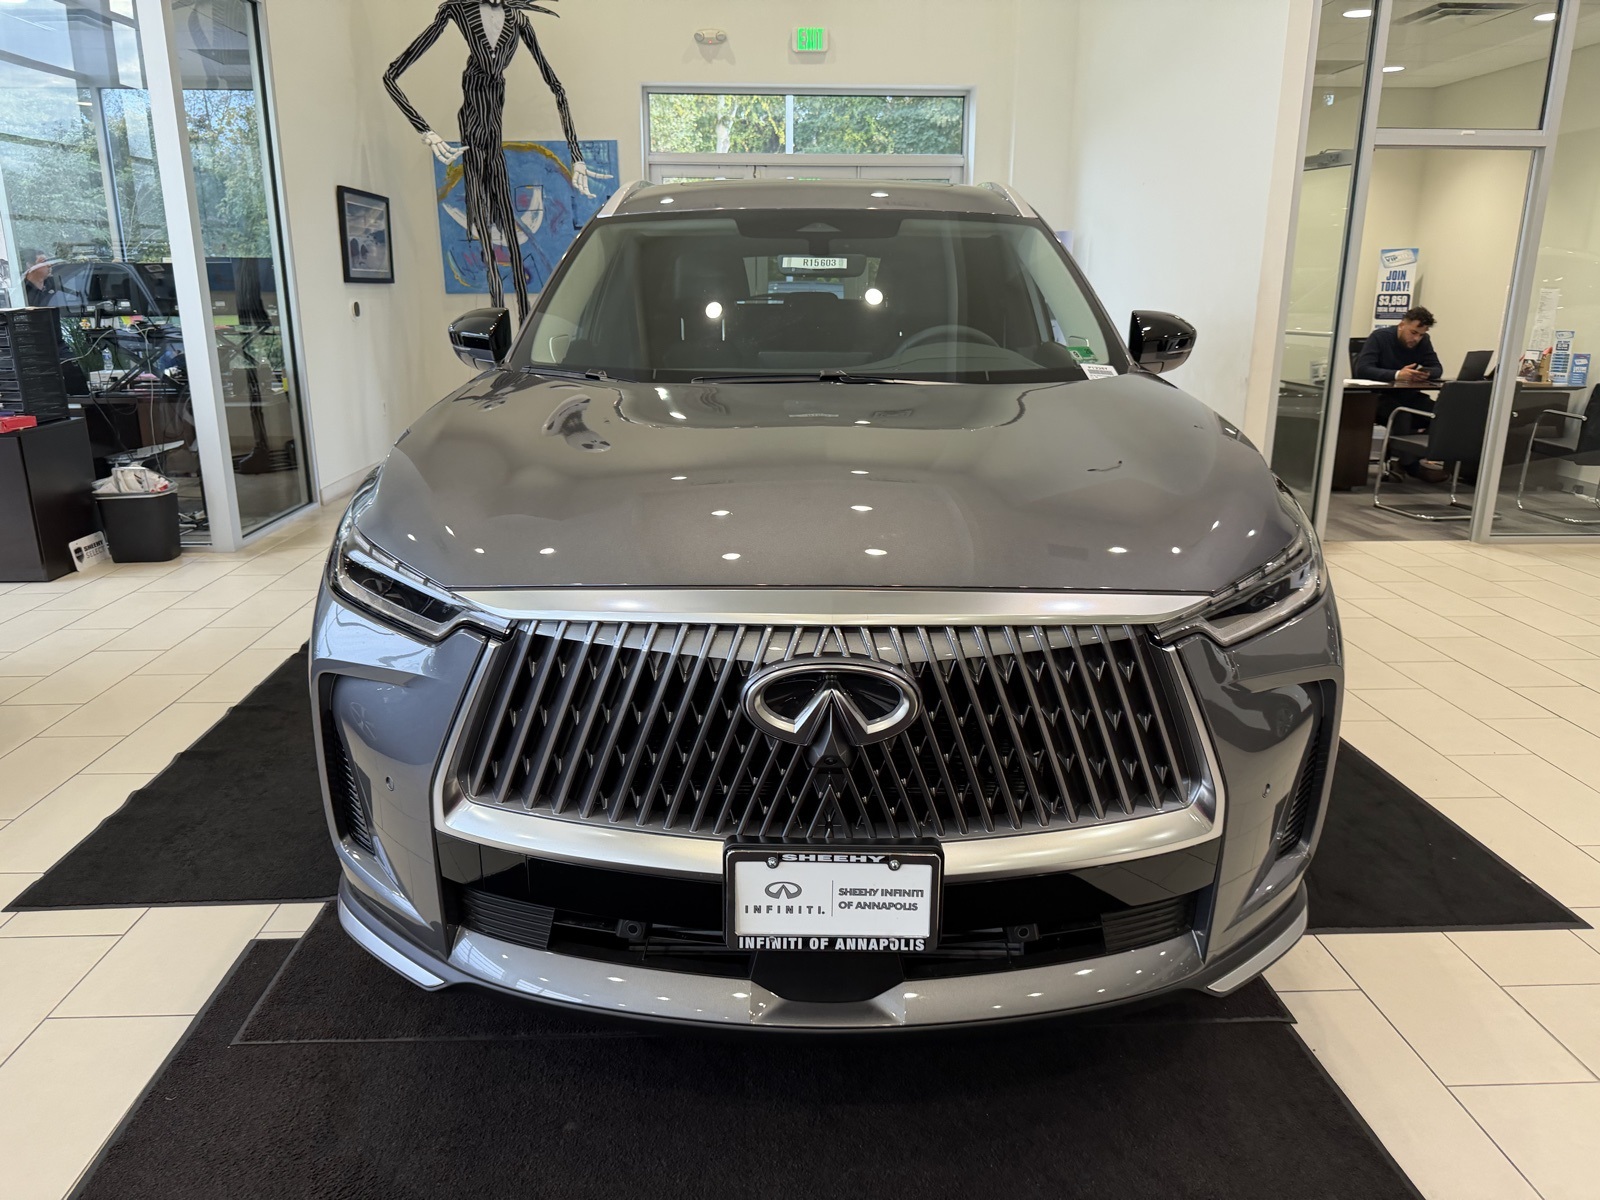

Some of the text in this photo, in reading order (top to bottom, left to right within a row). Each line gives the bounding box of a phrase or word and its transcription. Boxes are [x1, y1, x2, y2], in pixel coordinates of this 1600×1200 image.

[798, 27, 824, 50] EXIT
[803, 258, 837, 267] R15603
[1386, 270, 1407, 280] JOIN
[1381, 281, 1410, 292] TODAY!
[83, 540, 104, 551] SHEEHY
[782, 854, 886, 863] SHEEHY
[838, 888, 925, 898] SHEEHY INFINITI
[838, 901, 919, 911] OF ANNAPOLIS
[739, 936, 925, 951] INFINITI OF ANNAPOLIS
